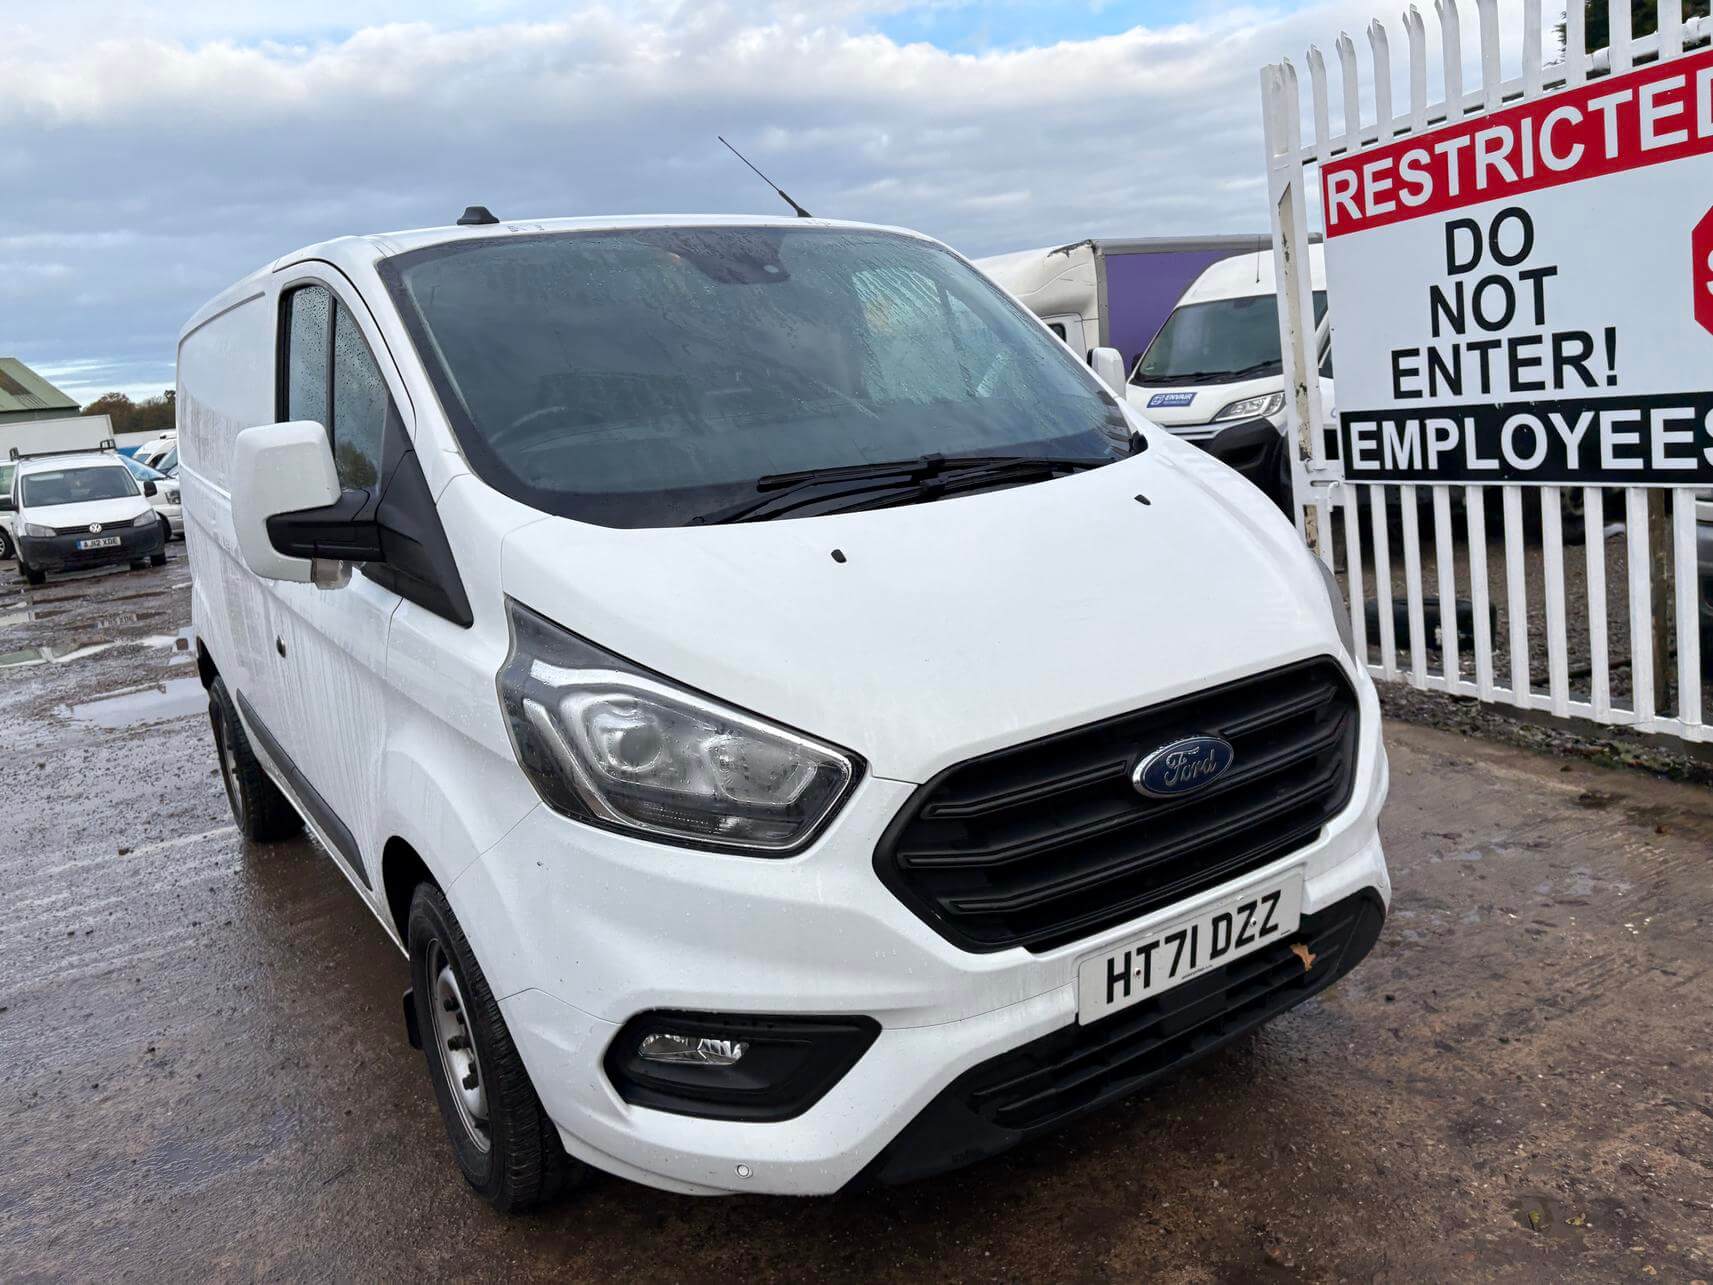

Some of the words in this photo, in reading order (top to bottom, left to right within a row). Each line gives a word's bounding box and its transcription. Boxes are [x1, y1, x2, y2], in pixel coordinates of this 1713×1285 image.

[1445, 207, 1534, 276] DO
[1430, 265, 1558, 338] NOT
[1391, 326, 1618, 400] ENTER!
[1349, 406, 1713, 471] EMPLOYEE
[1164, 745, 1217, 787] Ford
[1106, 924, 1199, 1004] HT71
[1209, 889, 1282, 961] DZZ
